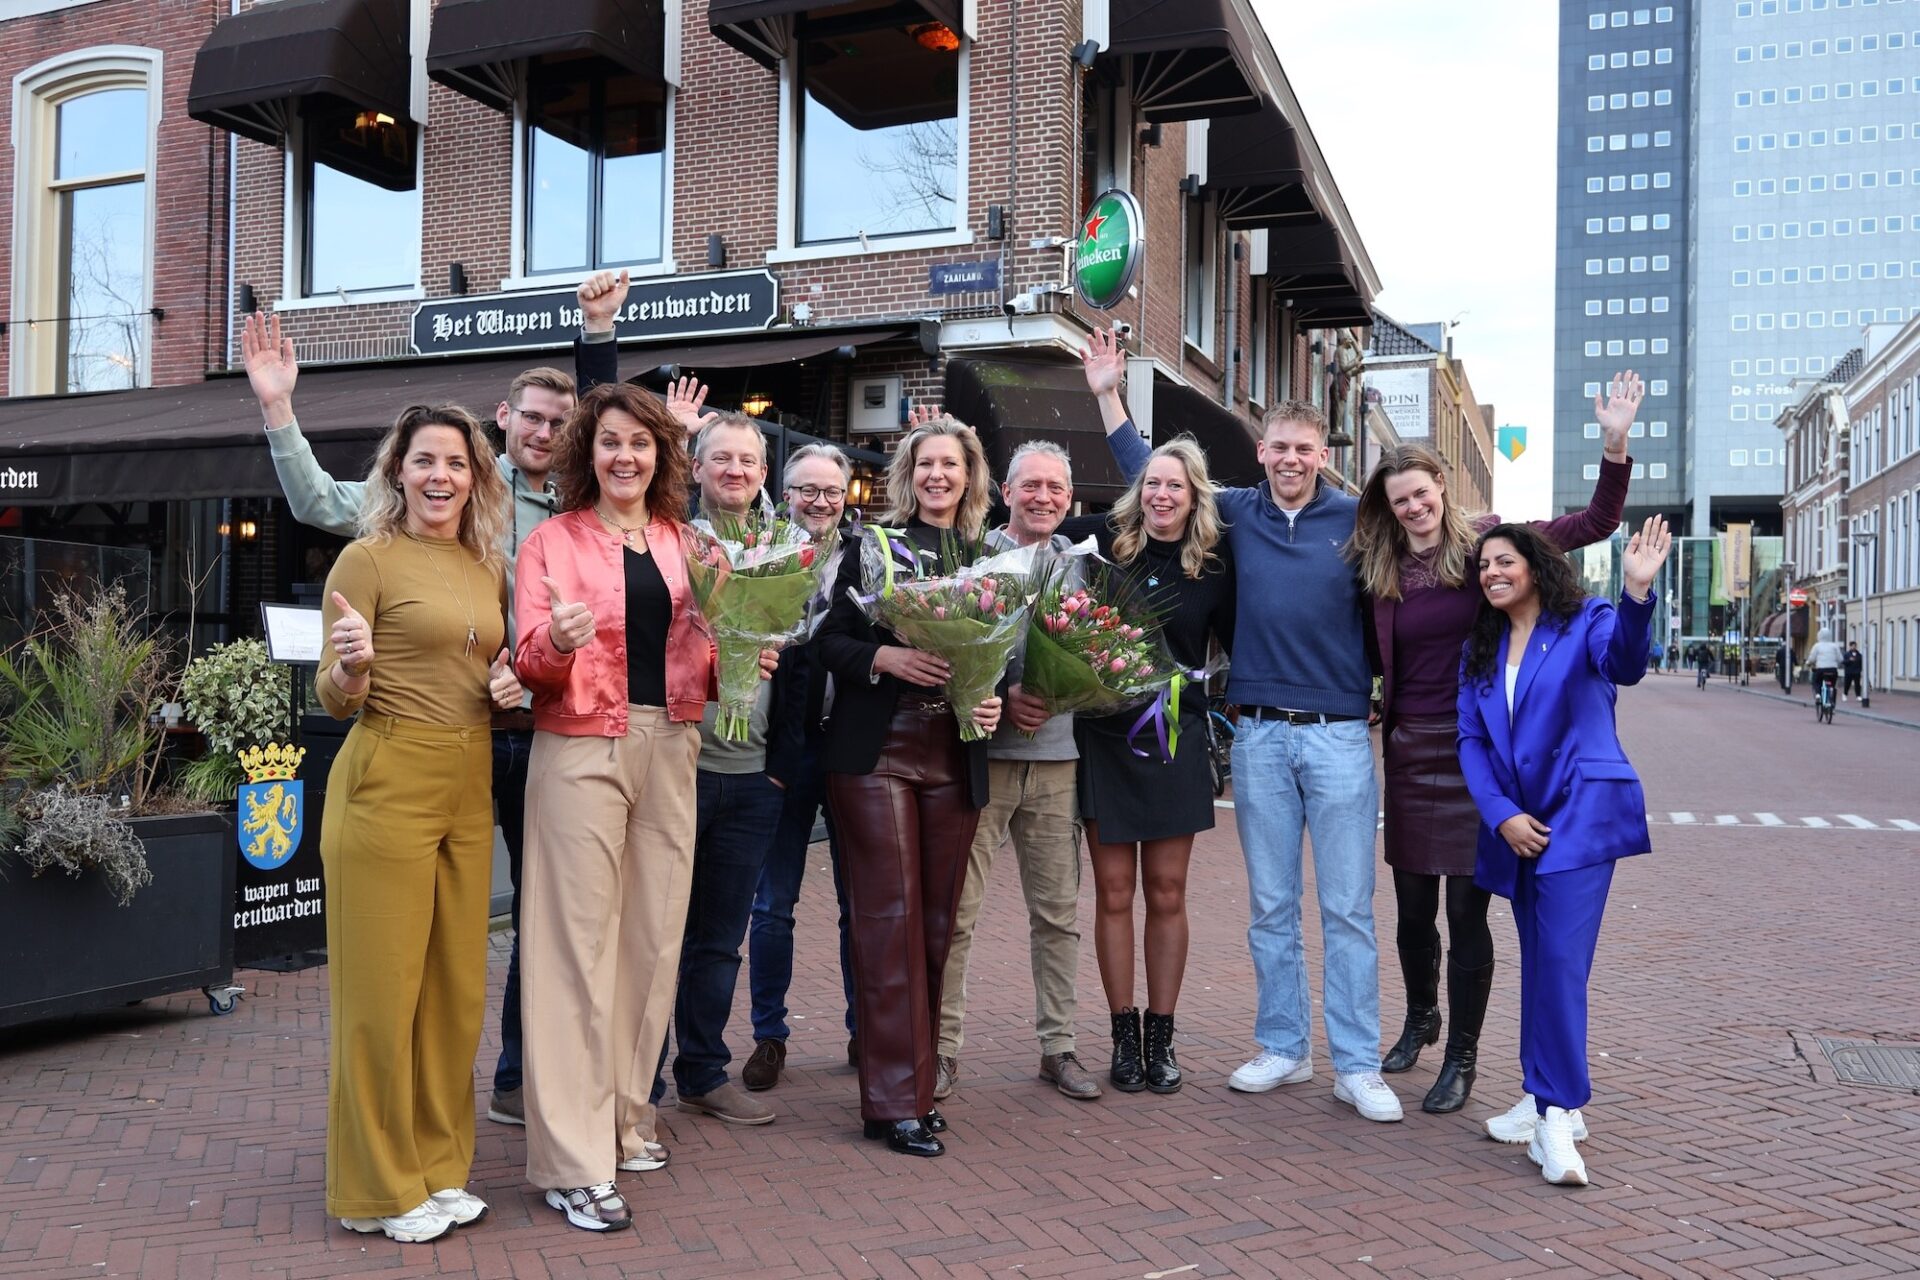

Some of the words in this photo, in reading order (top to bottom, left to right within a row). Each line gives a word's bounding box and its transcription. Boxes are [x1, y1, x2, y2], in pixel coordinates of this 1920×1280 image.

[1077, 248, 1121, 271] eineken
[432, 313, 472, 343] Het
[477, 308, 553, 337] Wapen
[559, 305, 584, 327] va
[1731, 385, 1751, 396] De
[244, 882, 289, 902] wapen
[295, 877, 320, 893] van
[233, 897, 322, 929] eeuwarden
